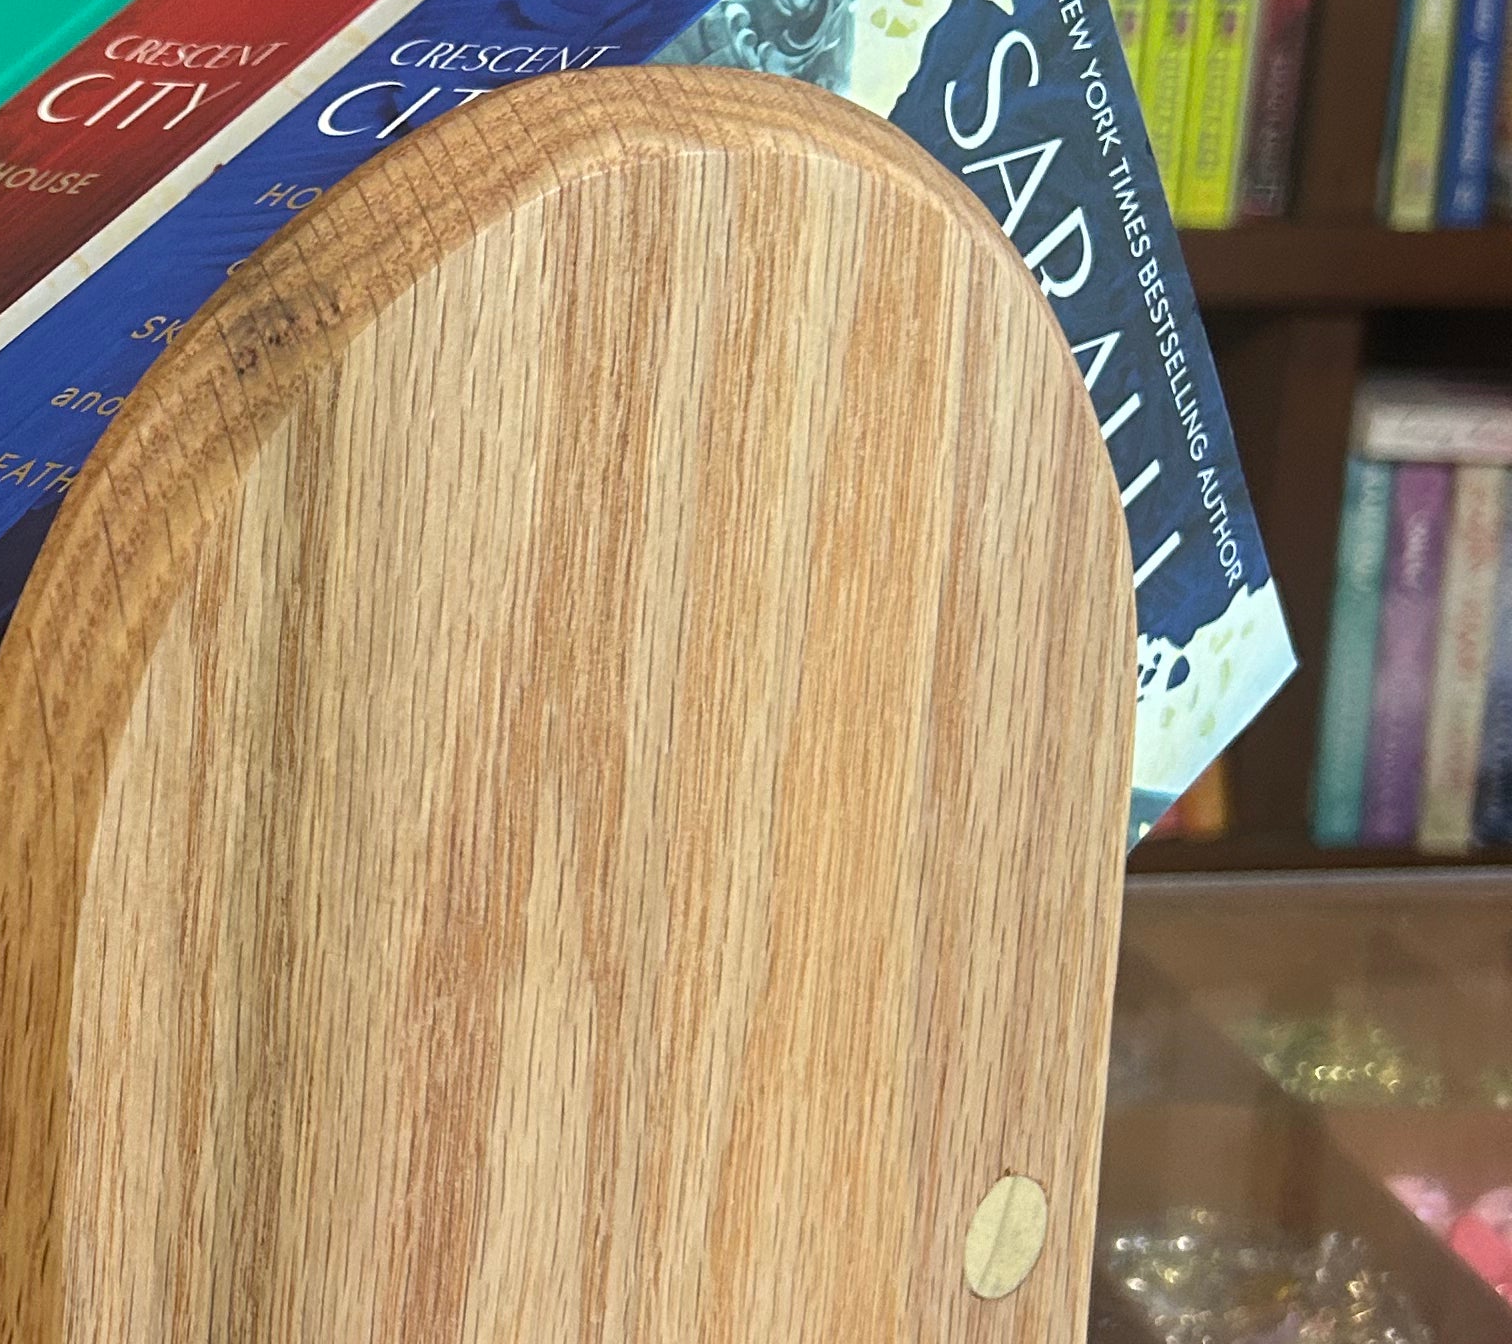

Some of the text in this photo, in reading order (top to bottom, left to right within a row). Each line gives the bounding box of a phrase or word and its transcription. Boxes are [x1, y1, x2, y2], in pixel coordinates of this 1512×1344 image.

[103, 34, 289, 69] CRESCENT
[389, 38, 622, 74] CRESCENT
[36, 72, 243, 131] CITY
[317, 80, 494, 140] CIT
[130, 314, 190, 346] SK
[1079, 57, 1123, 157] YORK
[1108, 157, 1152, 259] TIMES
[1137, 256, 1209, 463] BESTSELLING
[1197, 466, 1243, 589] AUTHOR
